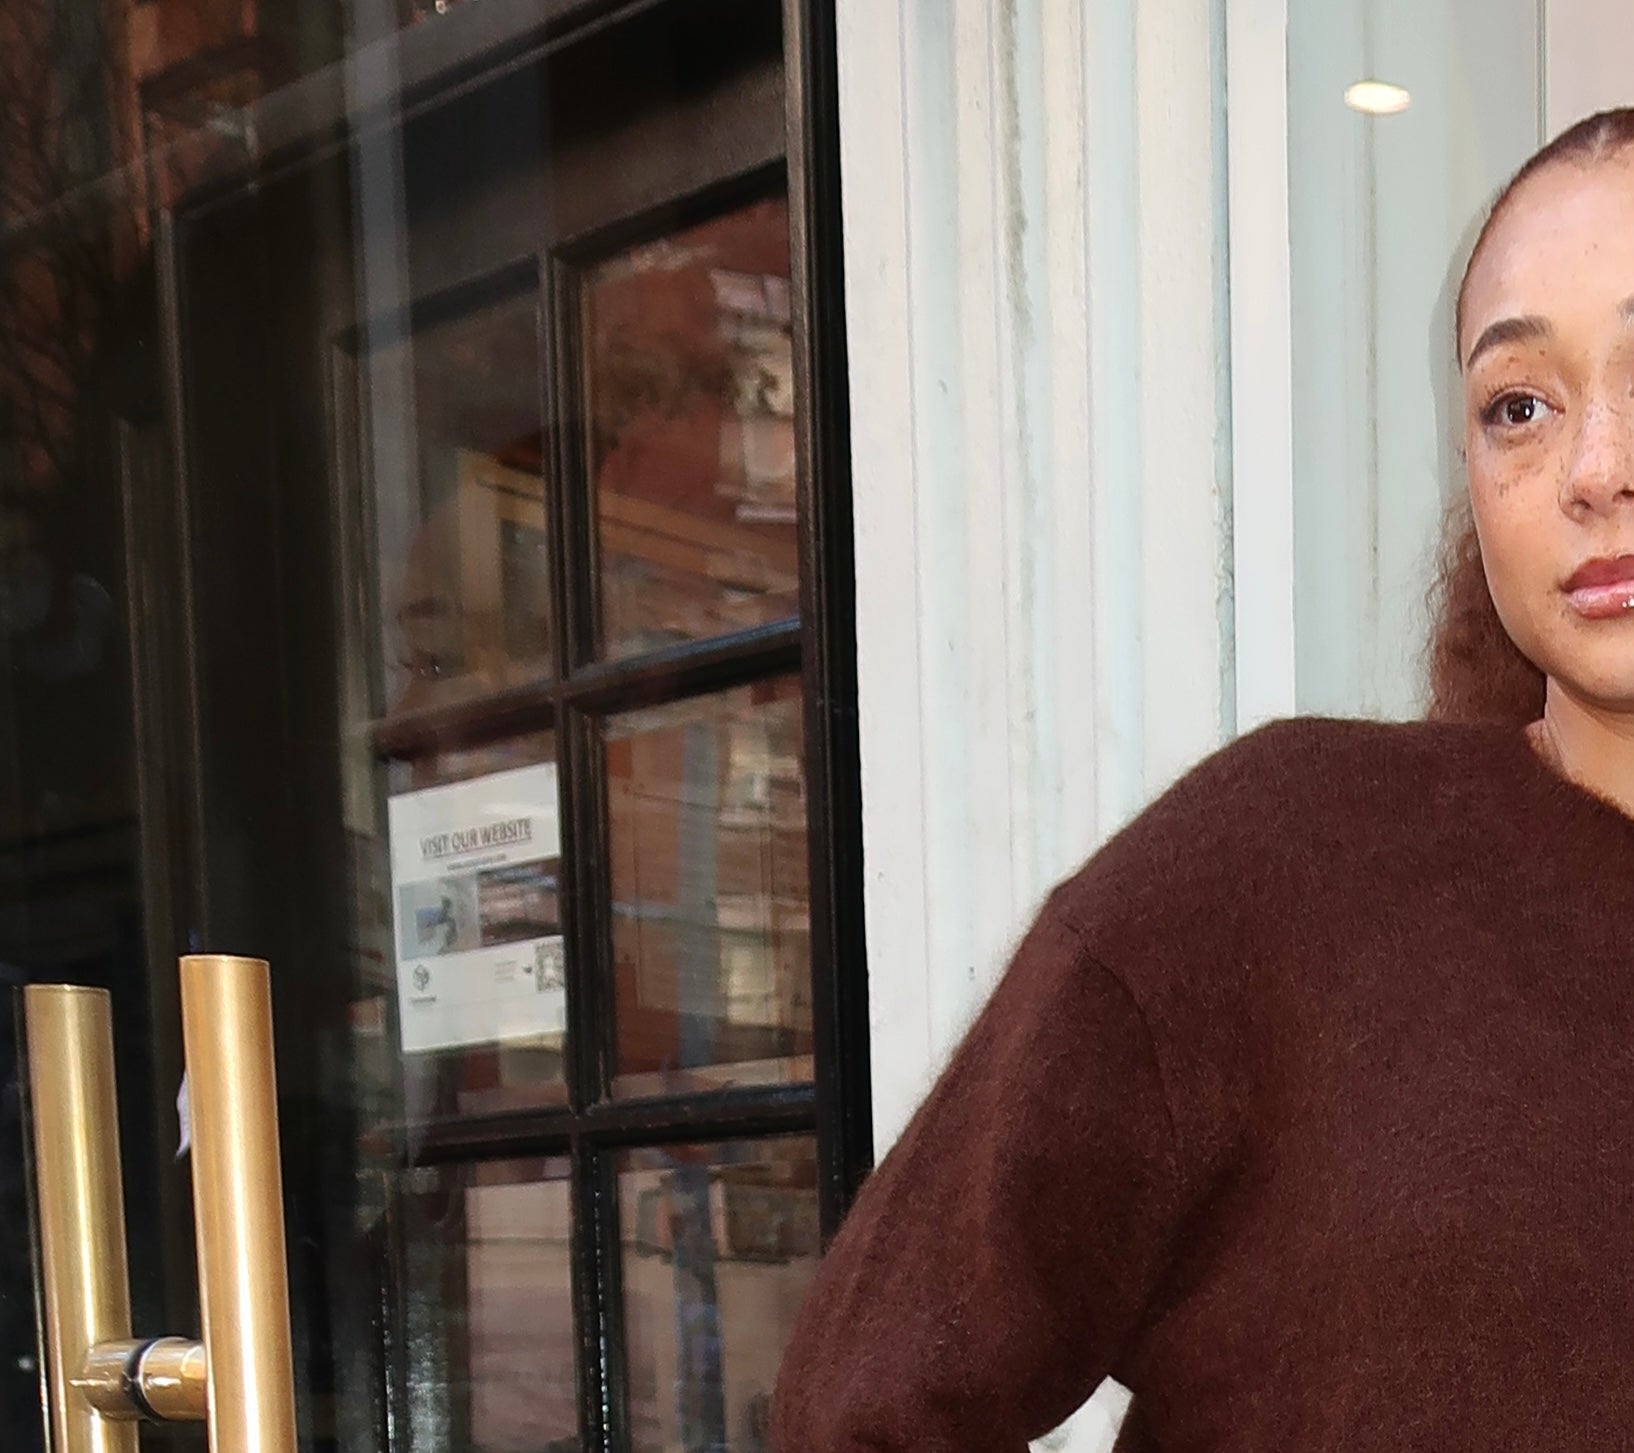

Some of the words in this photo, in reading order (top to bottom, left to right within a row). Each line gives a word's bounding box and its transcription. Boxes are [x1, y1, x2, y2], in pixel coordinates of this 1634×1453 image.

[420, 834, 449, 857] VISIT
[451, 828, 478, 852] OUR
[480, 817, 532, 845] WEBSITE
